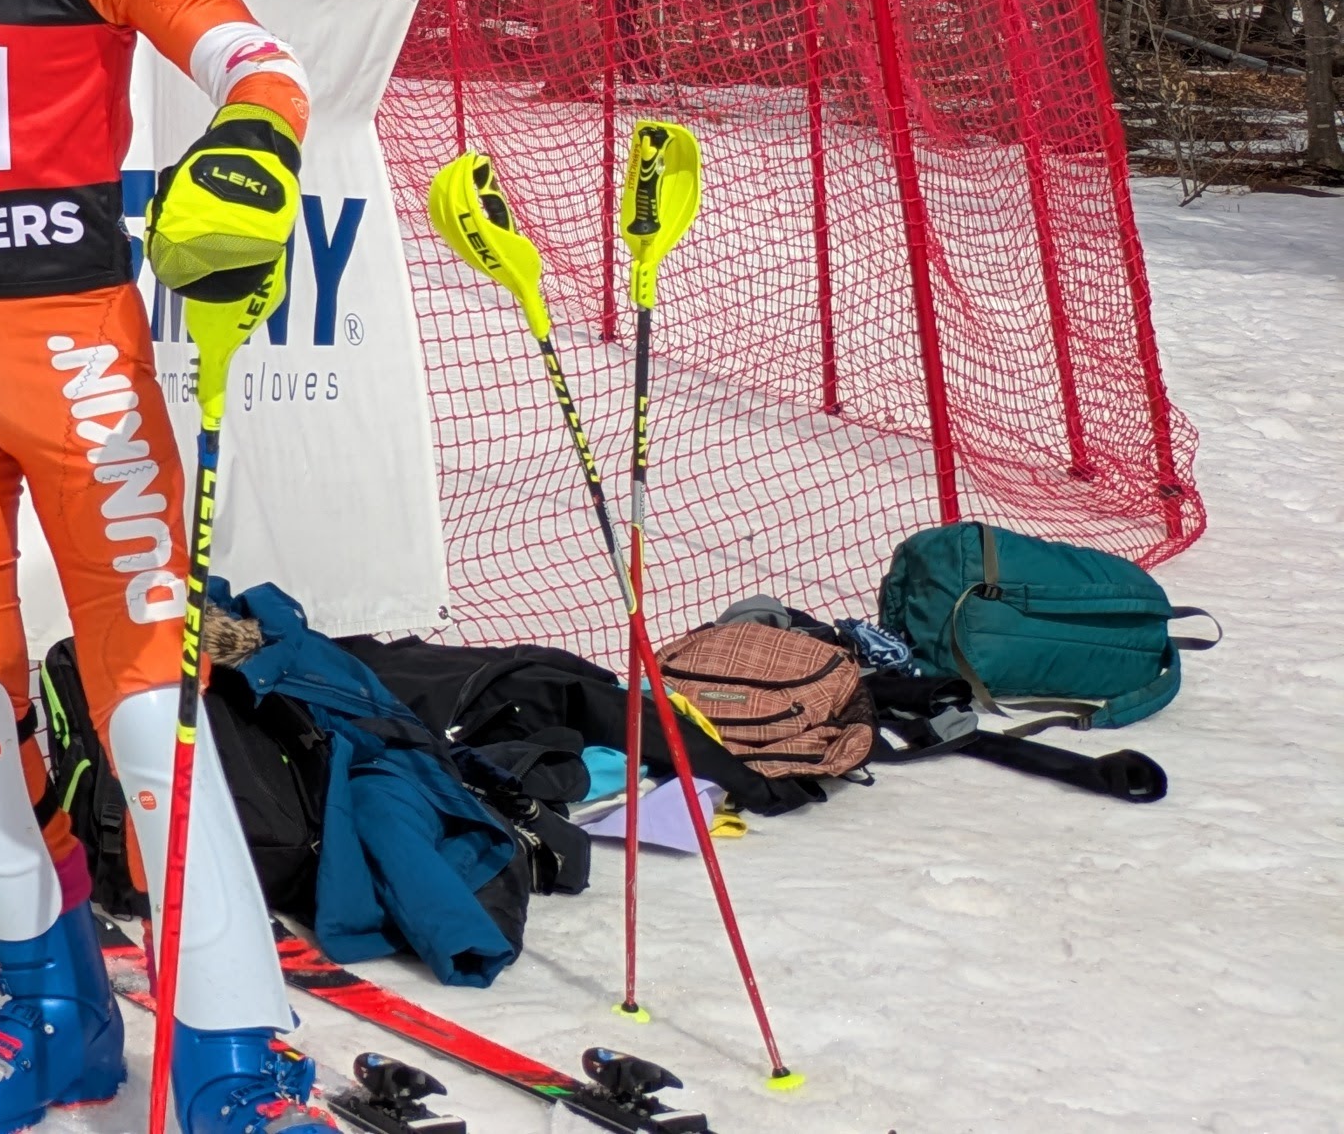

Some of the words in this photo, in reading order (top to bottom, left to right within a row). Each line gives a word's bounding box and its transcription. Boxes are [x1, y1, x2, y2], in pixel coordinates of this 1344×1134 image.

[212, 166, 268, 196] LEKI
[456, 212, 502, 272] LEKI
[237, 272, 275, 332] LEK
[243, 361, 340, 412] gloves
[568, 412, 601, 483] LEKI
[637, 396, 648, 467] LEKI
[46, 335, 188, 625] DUNKIN'
[197, 469, 217, 567] LEKI
[181, 574, 204, 678] LEKI
